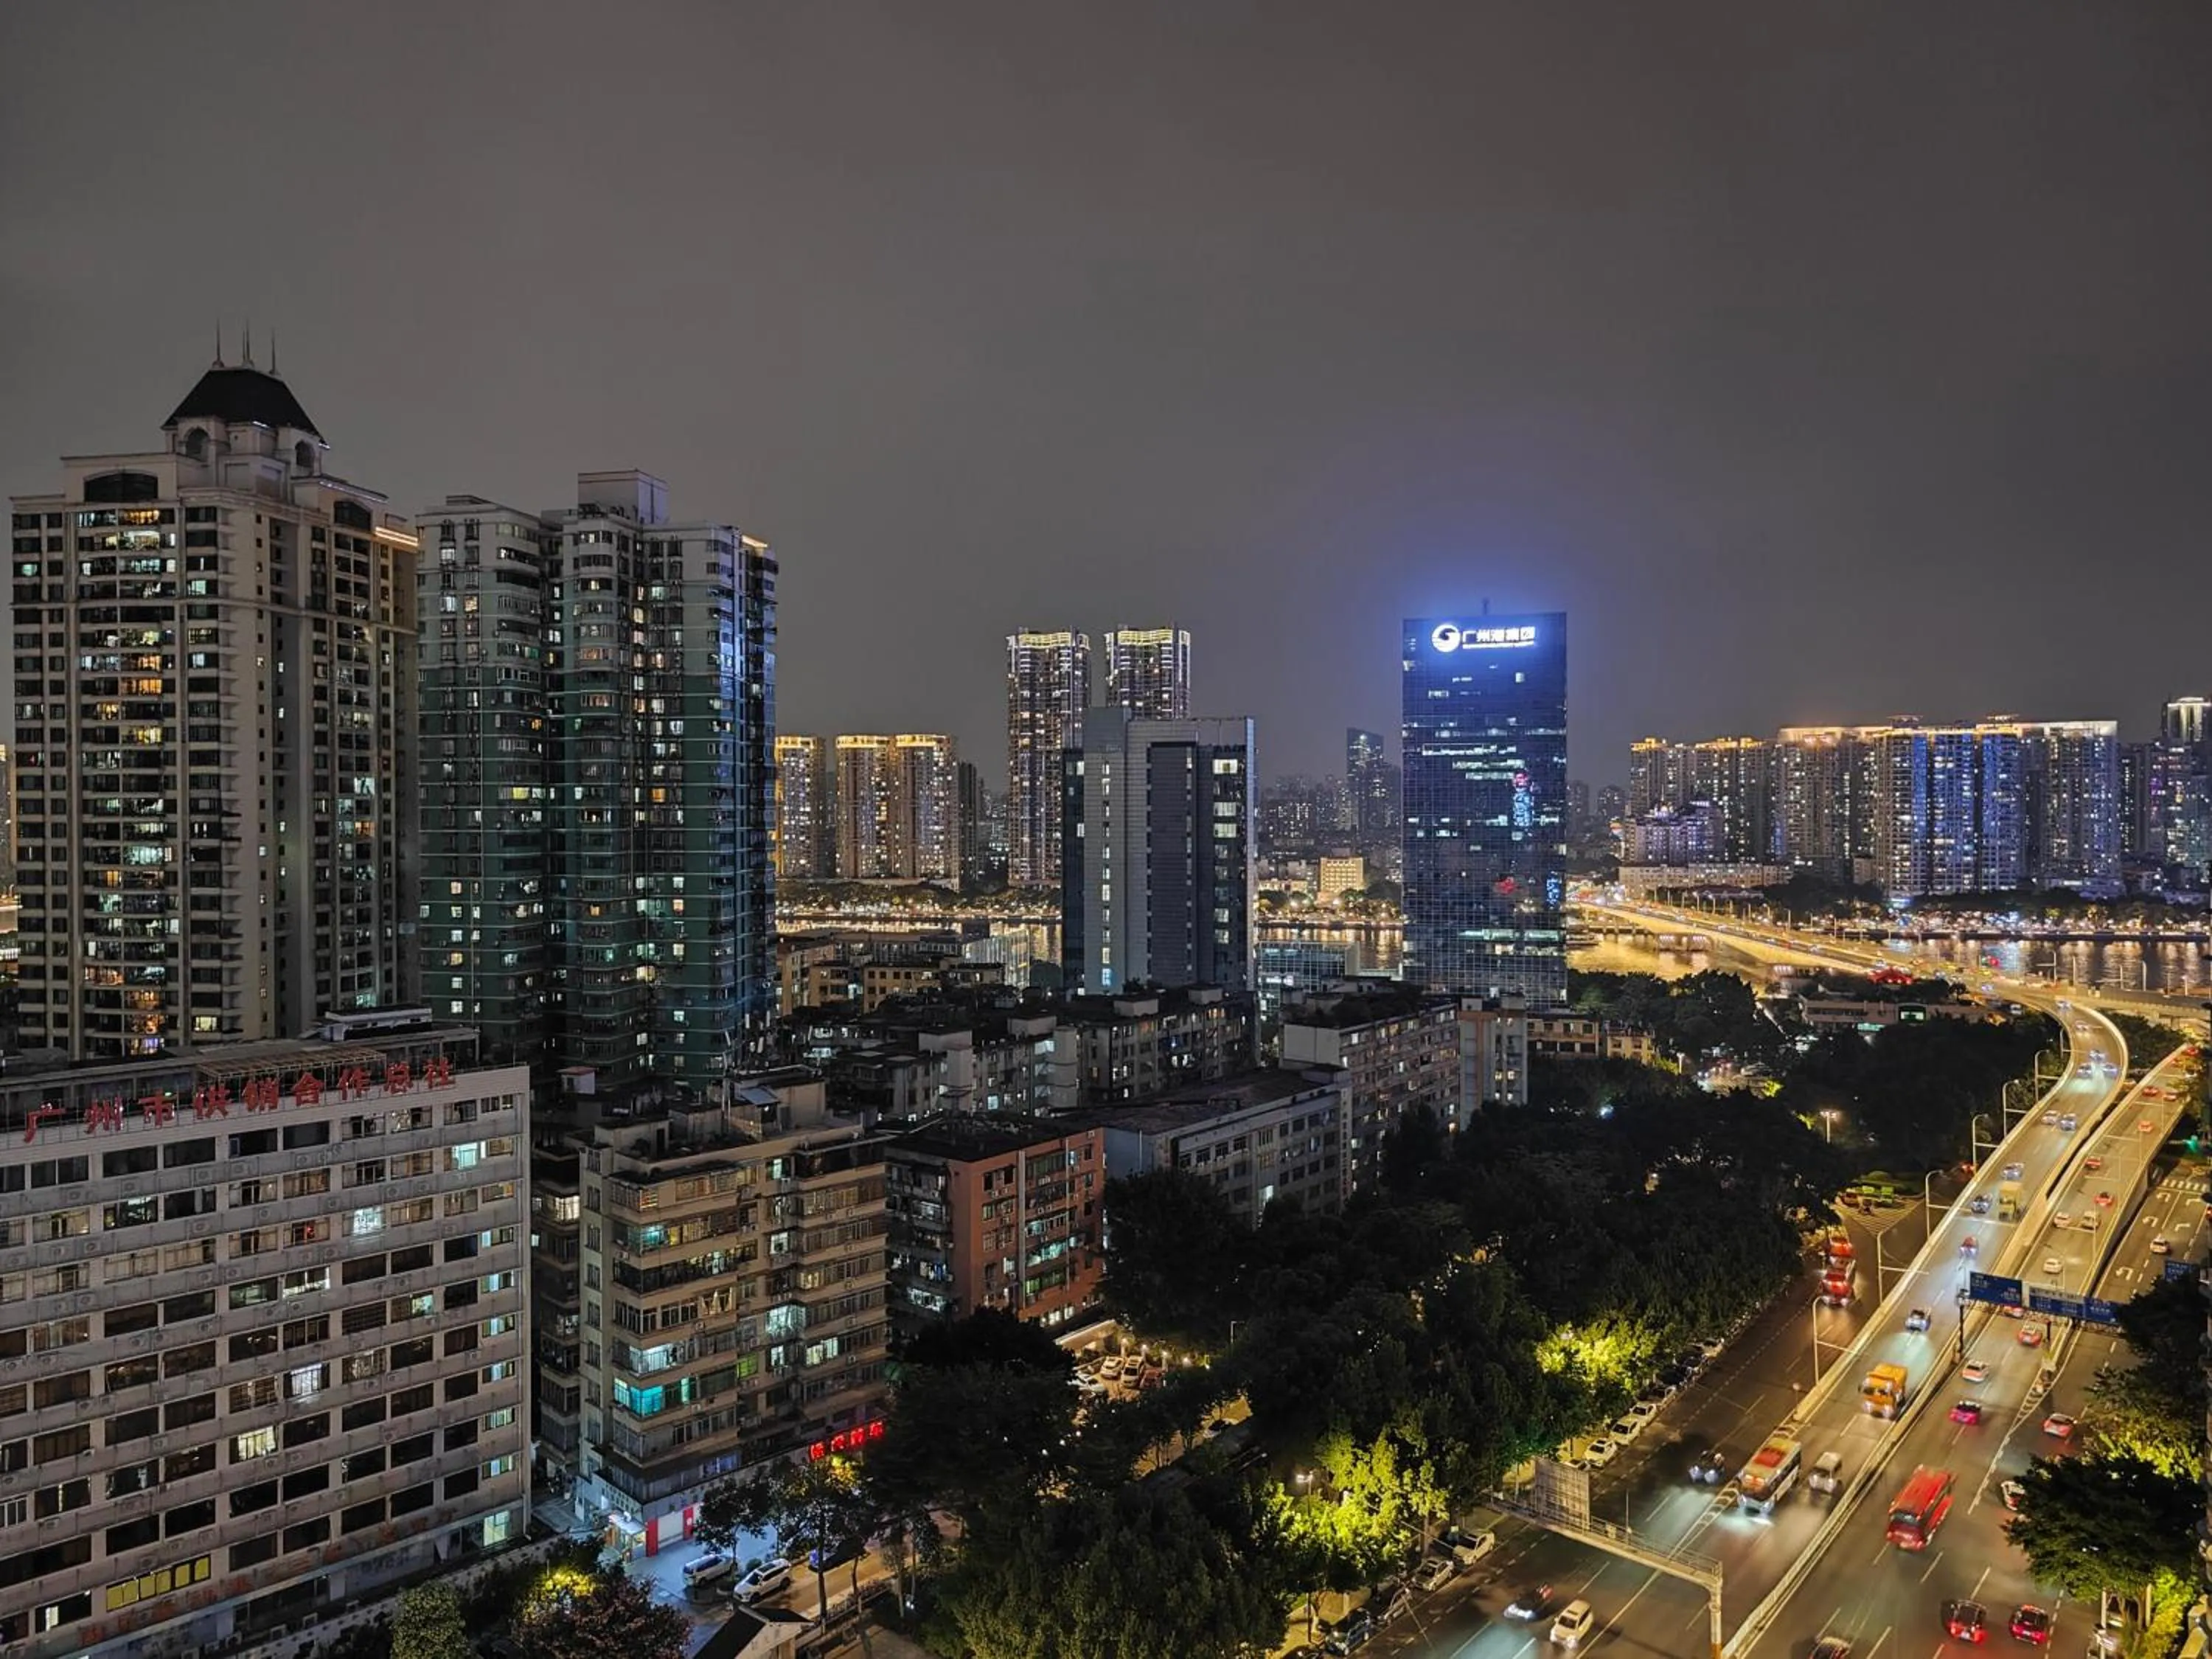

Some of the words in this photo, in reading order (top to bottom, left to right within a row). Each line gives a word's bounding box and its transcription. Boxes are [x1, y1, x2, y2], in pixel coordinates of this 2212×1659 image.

[24, 1057, 455, 1143] 广州市供销合作总社
